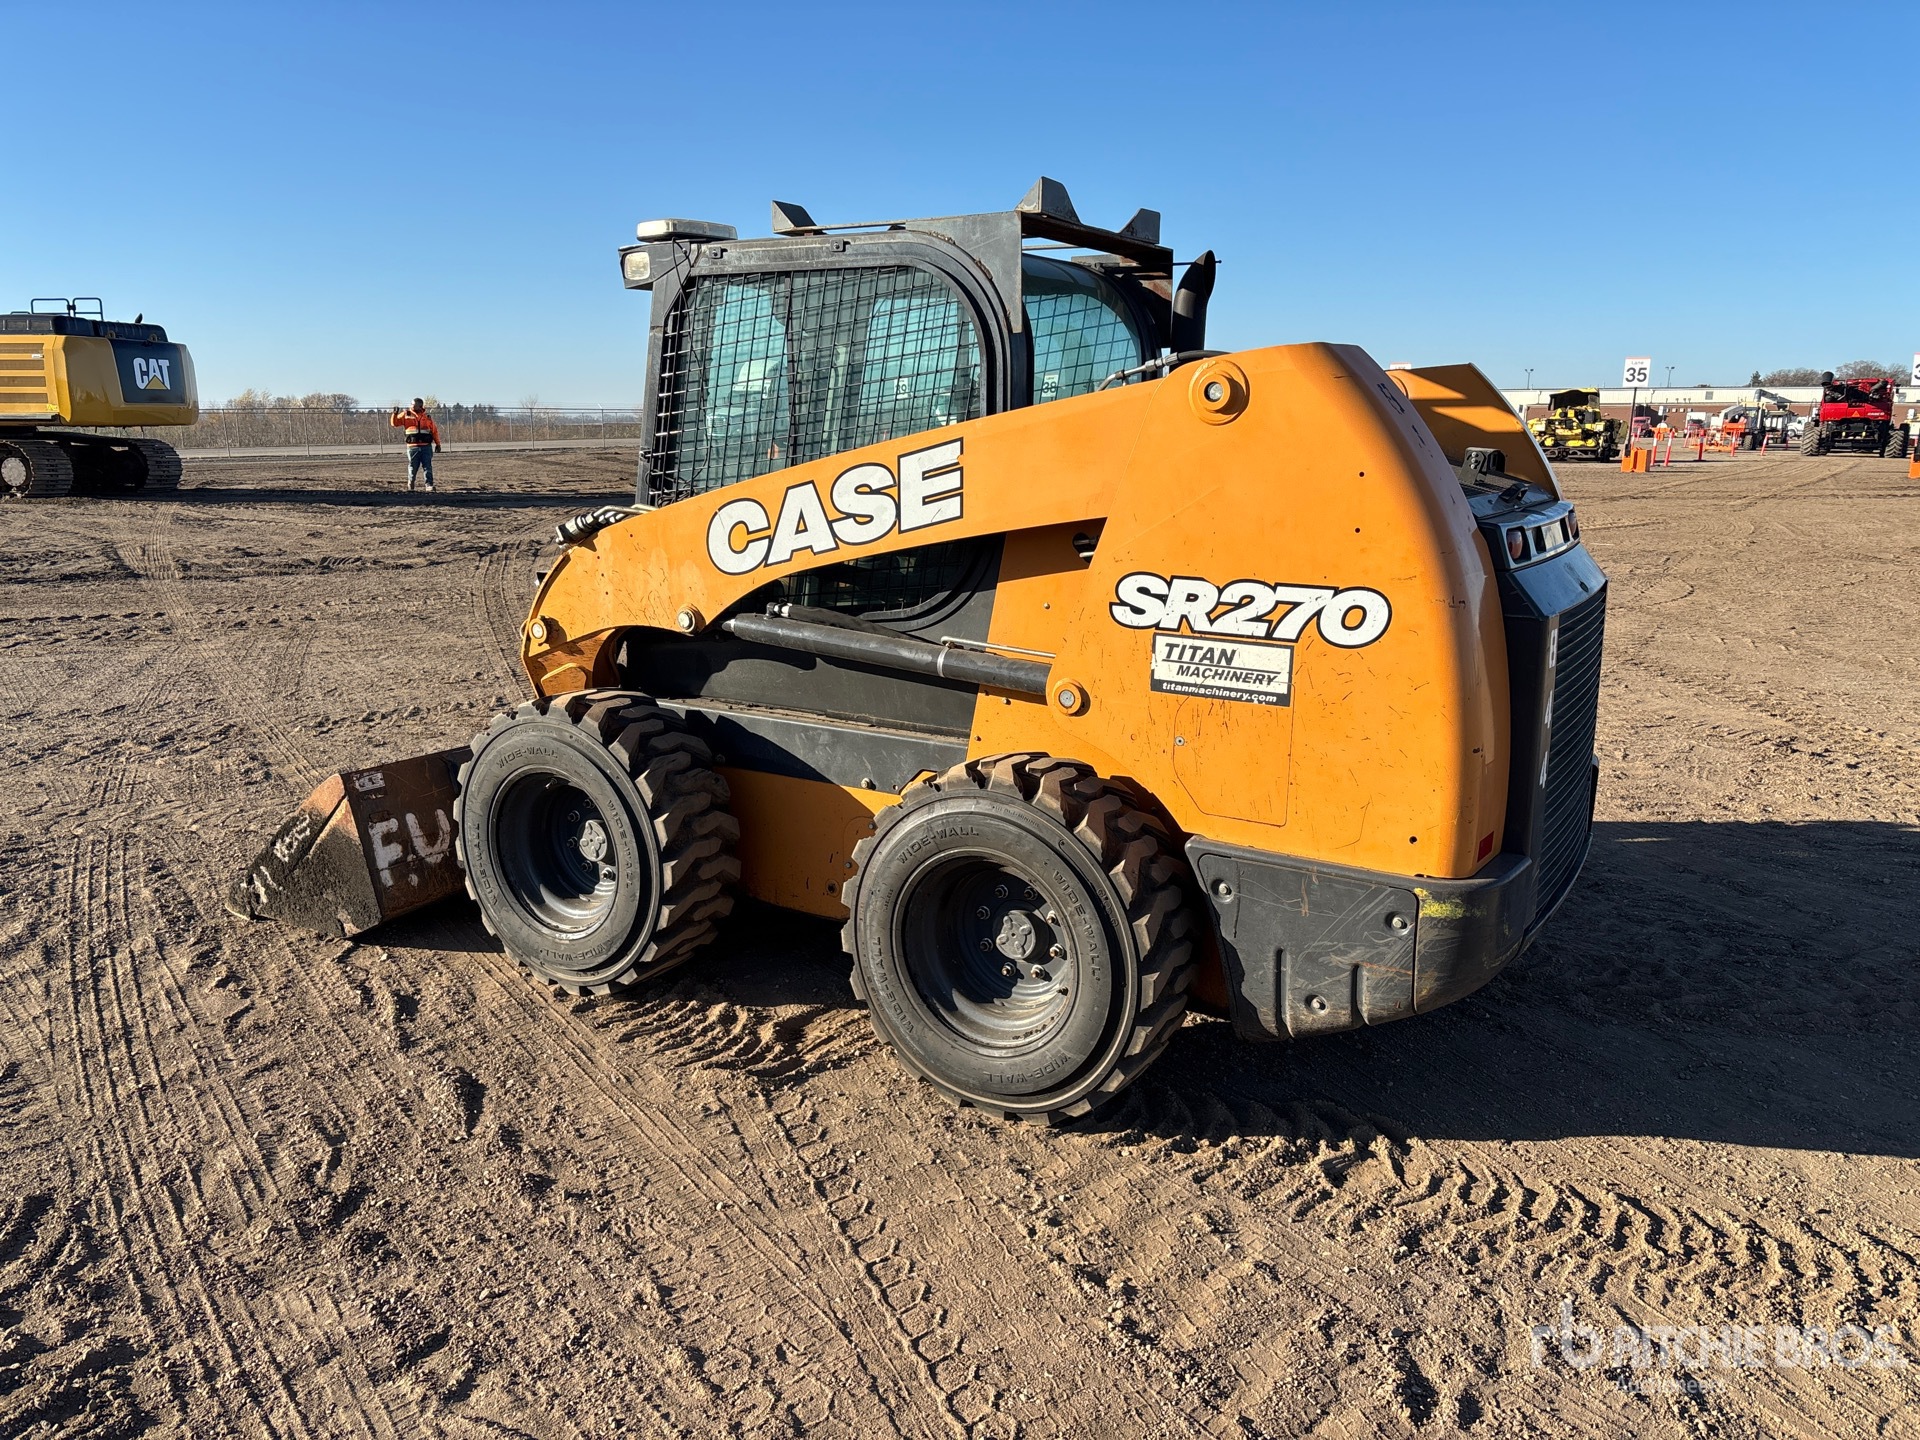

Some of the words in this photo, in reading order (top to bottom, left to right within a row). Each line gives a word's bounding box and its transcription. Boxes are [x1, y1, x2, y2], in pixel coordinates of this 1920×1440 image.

[133, 357, 171, 390] CAT
[1625, 367, 1647, 383] 35
[706, 437, 964, 576] CASE
[1109, 571, 1393, 649] SR270
[1164, 642, 1237, 666] TITAN
[1176, 665, 1278, 687] MACHINERY
[1162, 682, 1278, 703] titanmachinery.com
[497, 746, 559, 770] WIDE-WALL
[896, 826, 980, 865] WIDE-WALL
[1053, 870, 1101, 976] WIDE-WALL
[871, 935, 916, 1034] WIDE-WALL
[986, 1053, 1073, 1085] WIDE-WALL
